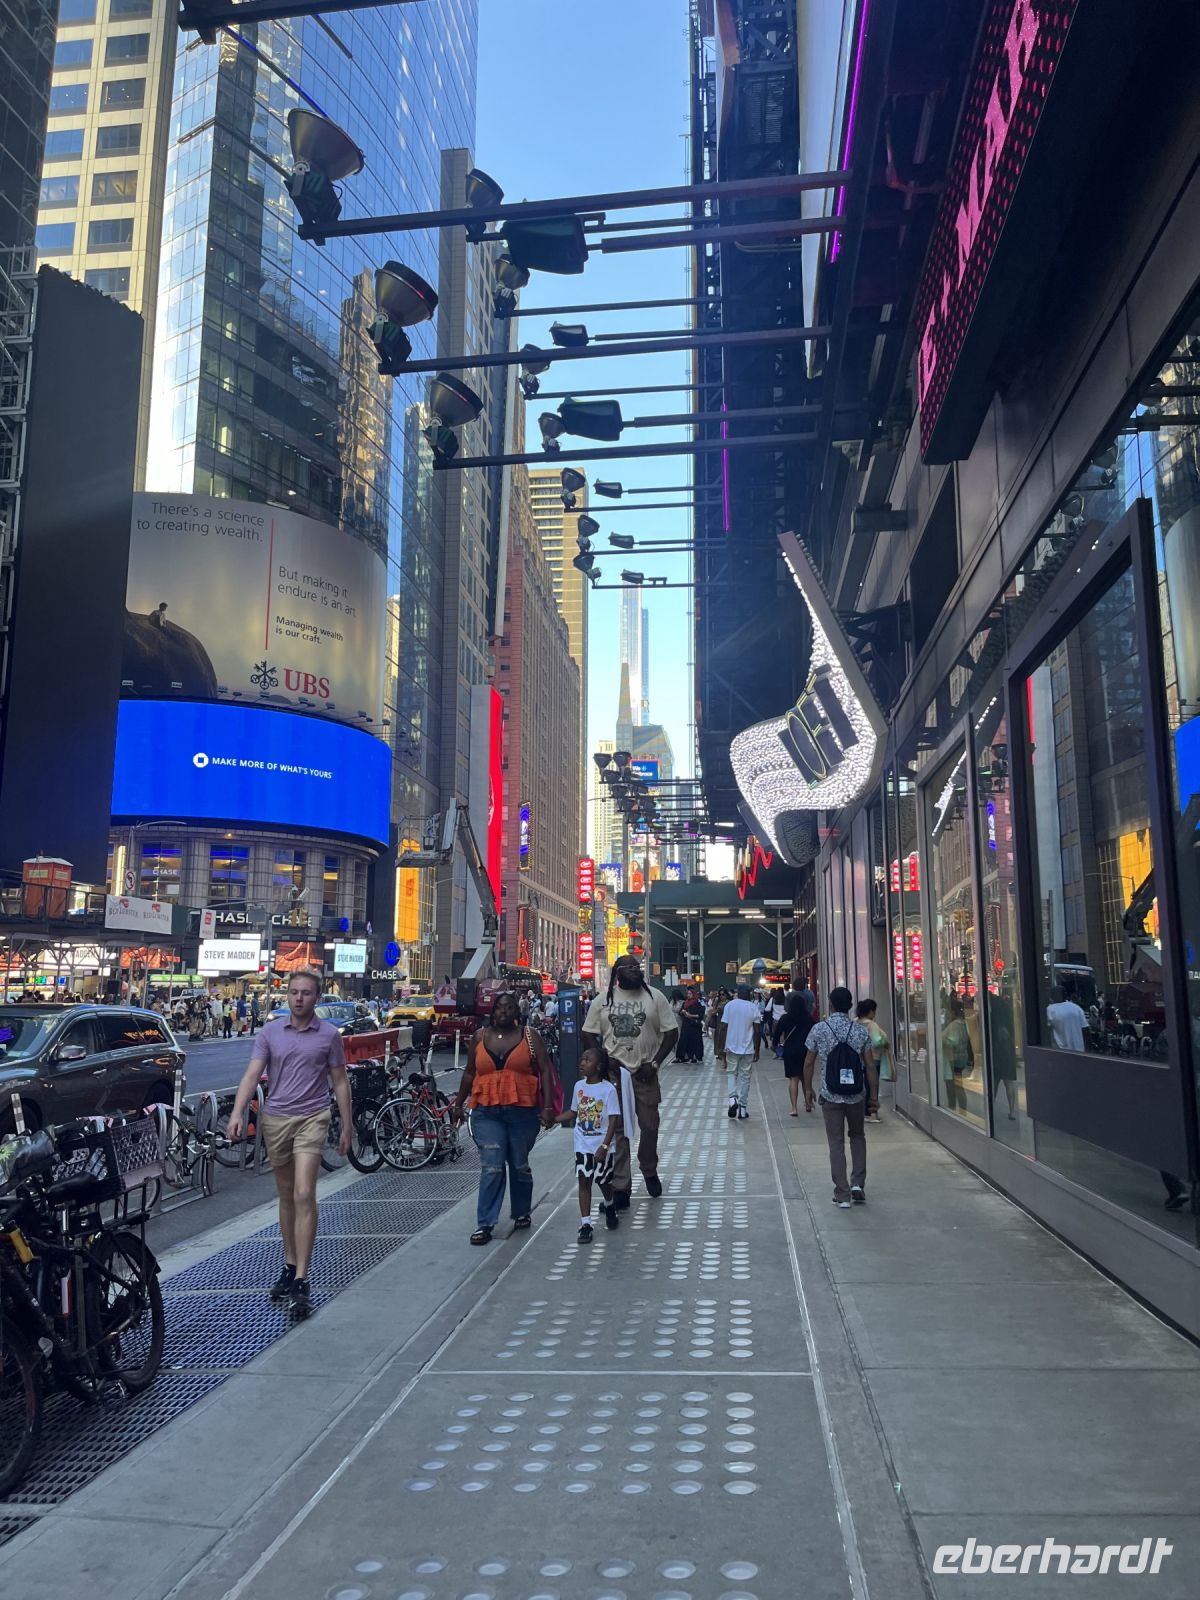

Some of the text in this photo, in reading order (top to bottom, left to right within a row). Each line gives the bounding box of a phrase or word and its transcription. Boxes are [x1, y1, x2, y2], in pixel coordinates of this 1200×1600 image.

[152, 502, 265, 527] There's a science
[137, 519, 263, 542] to creating wealth.
[278, 566, 349, 599] But making it
[277, 583, 318, 601] endure
[320, 595, 328, 606] is
[331, 599, 342, 611] an
[275, 625, 321, 645] is our craft.
[276, 615, 344, 642] Managing wealth
[283, 668, 330, 699] UBS
[212, 757, 332, 779] MAKE MORE OF WHAT'S YOURS
[204, 951, 256, 961] STEVE MADDEN
[371, 969, 397, 980] CHASE
[564, 1000, 573, 1013] P
